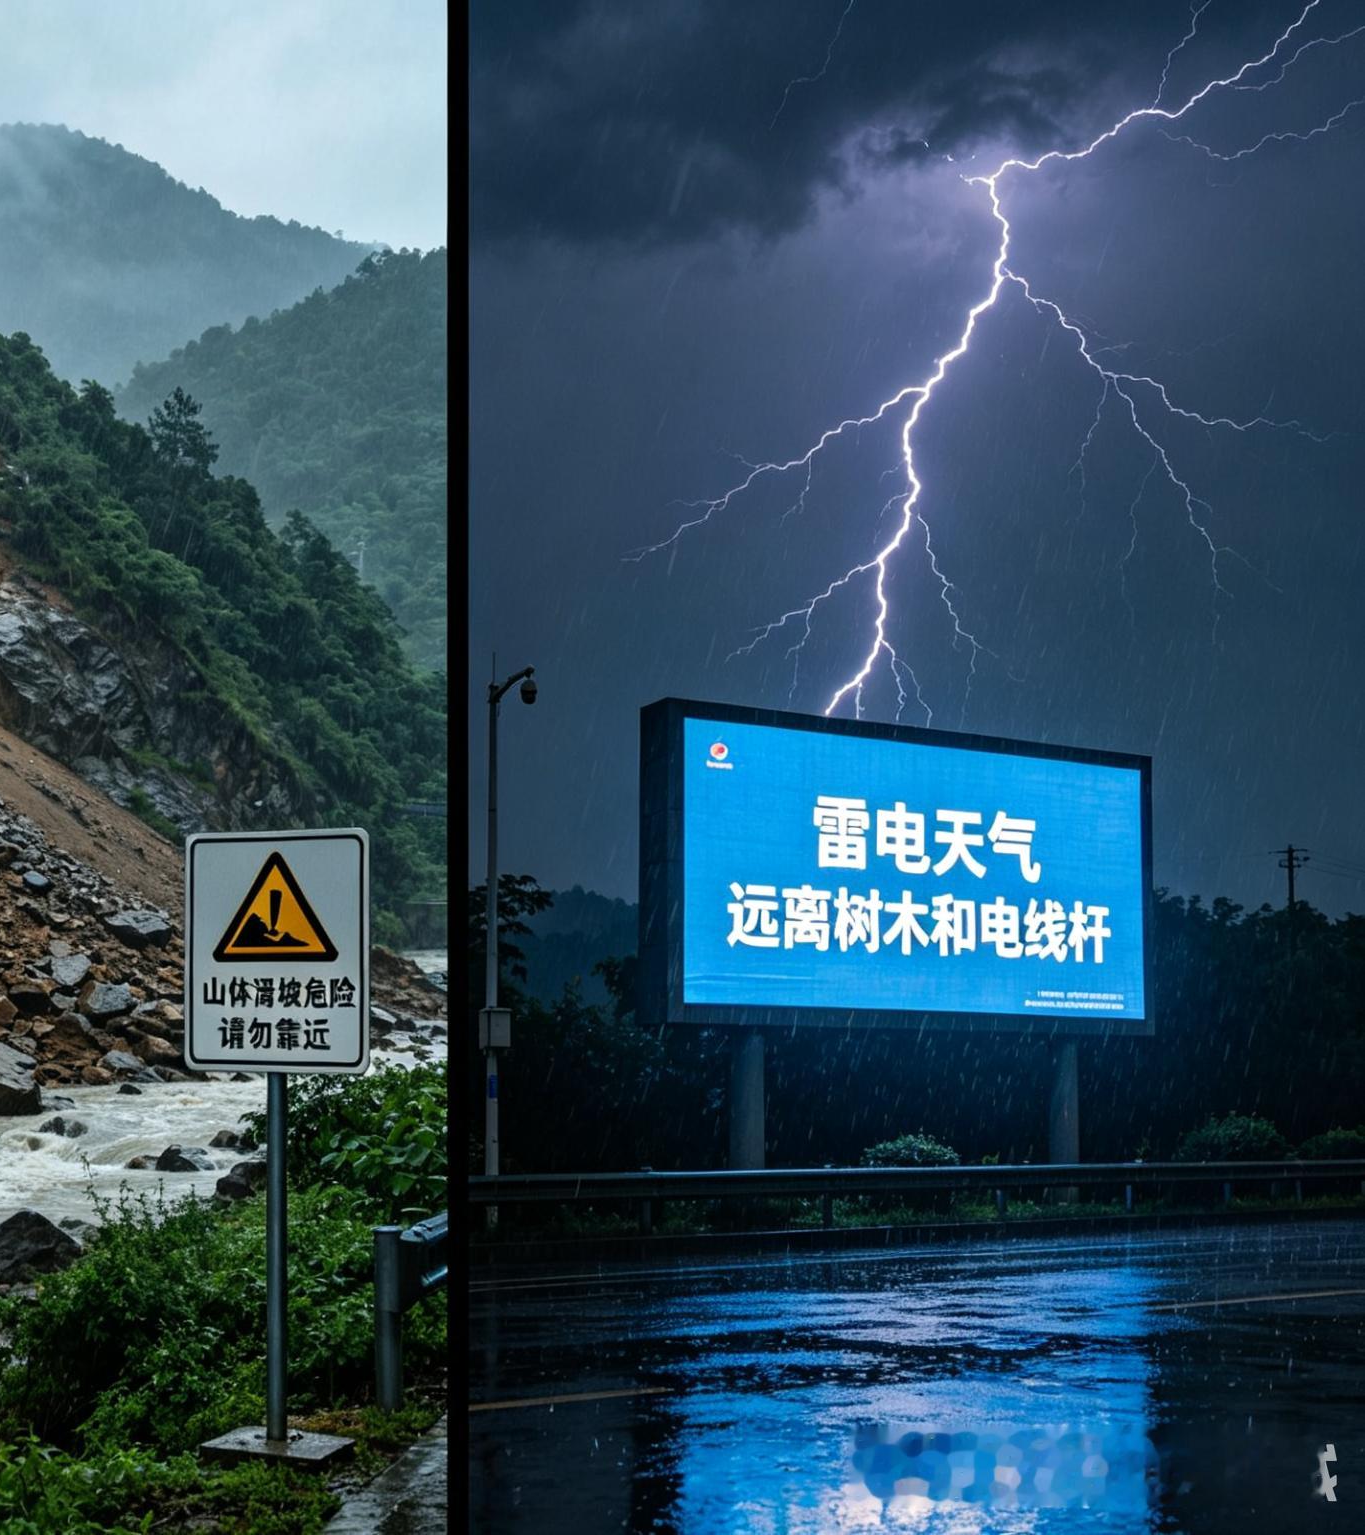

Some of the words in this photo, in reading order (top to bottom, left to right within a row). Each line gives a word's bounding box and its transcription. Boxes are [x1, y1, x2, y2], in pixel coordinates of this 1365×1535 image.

[813, 795, 1041, 883] 雷电天气
[727, 882, 1112, 964] 远离树木和电线杆
[217, 1017, 331, 1050] 请勿靠近
